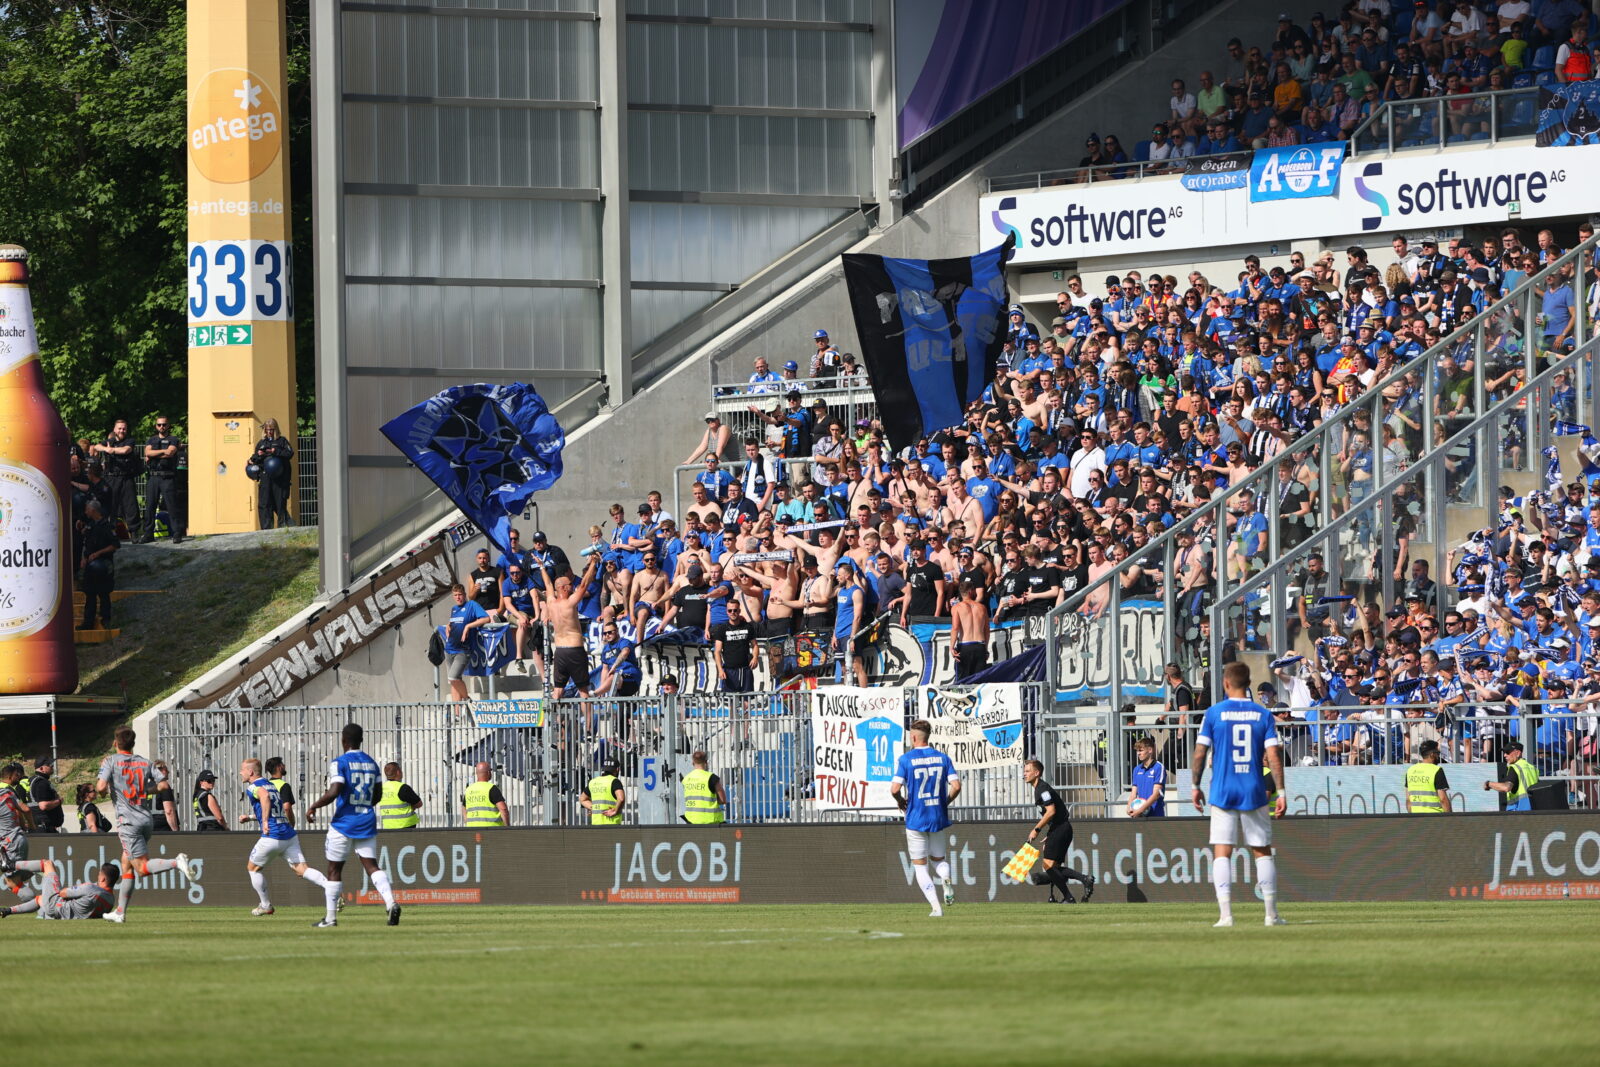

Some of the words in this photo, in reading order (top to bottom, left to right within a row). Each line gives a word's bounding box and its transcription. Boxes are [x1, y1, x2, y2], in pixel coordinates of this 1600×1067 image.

[192, 112, 278, 150] entega
[1258, 153, 1282, 192] A
[1318, 148, 1342, 187] F
[201, 198, 284, 216] entega.de
[1398, 168, 1548, 216] software
[1550, 169, 1566, 184] AG
[1030, 203, 1167, 248] software
[1168, 206, 1183, 218] AG
[0, 541, 52, 567] acher
[816, 692, 862, 718] TAUSCHE
[824, 720, 855, 746] PAPA
[929, 725, 943, 736] ARF
[1232, 724, 1252, 763] 9
[815, 745, 853, 773] GEGEN
[871, 734, 889, 763] 10
[954, 739, 988, 764] TRIKOT
[121, 767, 147, 799] 31
[349, 772, 376, 806] 33
[643, 757, 657, 792] 5
[816, 774, 869, 808] TRIKOT
[914, 766, 944, 799] 27
[899, 834, 978, 886] vit
